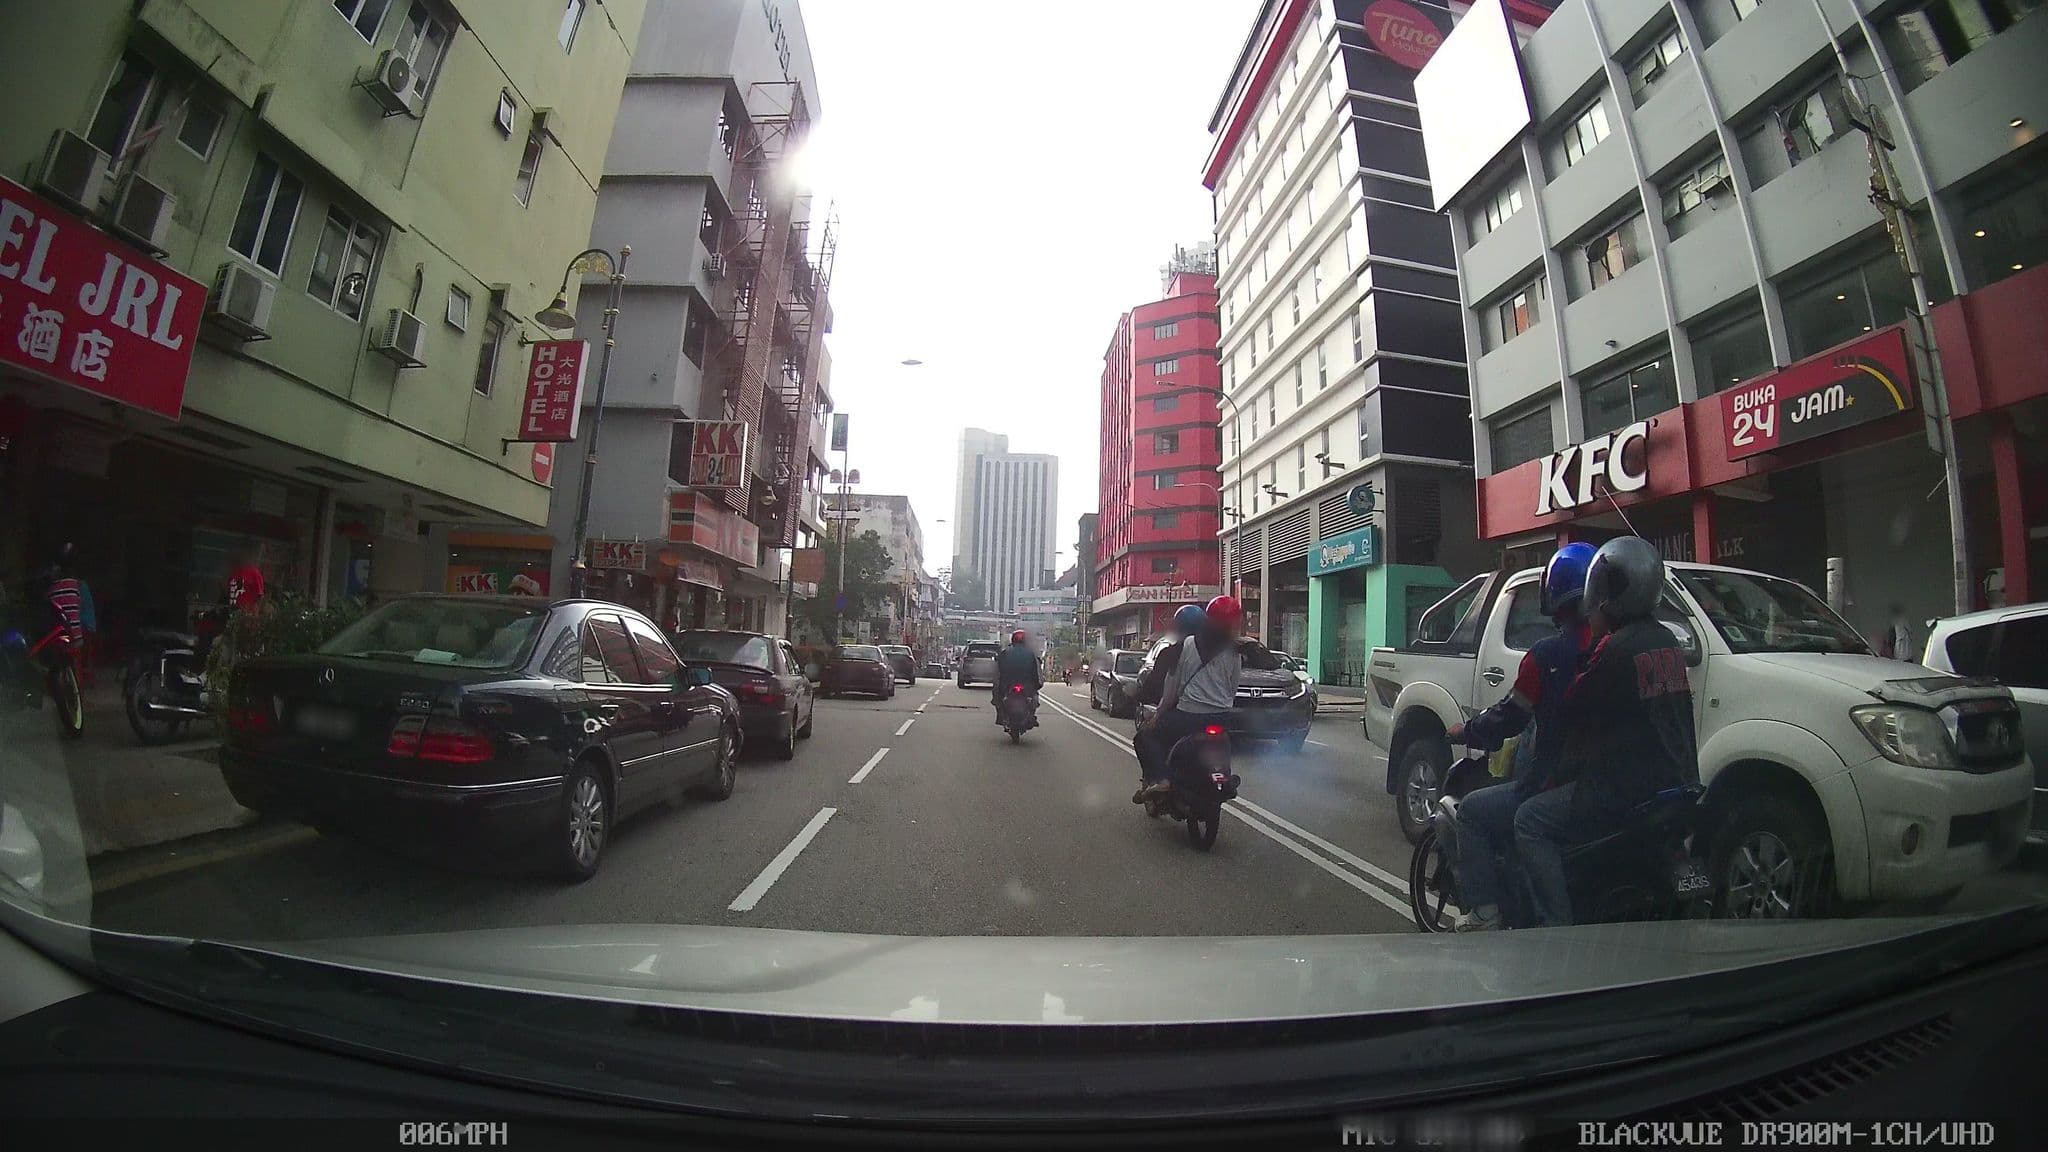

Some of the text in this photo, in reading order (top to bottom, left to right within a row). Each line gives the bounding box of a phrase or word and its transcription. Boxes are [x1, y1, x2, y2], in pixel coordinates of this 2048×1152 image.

[1372, 11, 1439, 48] Tune
[79, 252, 183, 350] JRL
[527, 346, 558, 432] HOTEL
[550, 356, 575, 421] 大光酒店
[1733, 384, 1776, 413] BUKA
[1732, 383, 1845, 447] 24 JAM
[696, 422, 742, 454] KK
[708, 457, 724, 485] 24
[1534, 420, 1652, 517] KFC
[604, 543, 633, 559] KK
[461, 574, 492, 592] KK
